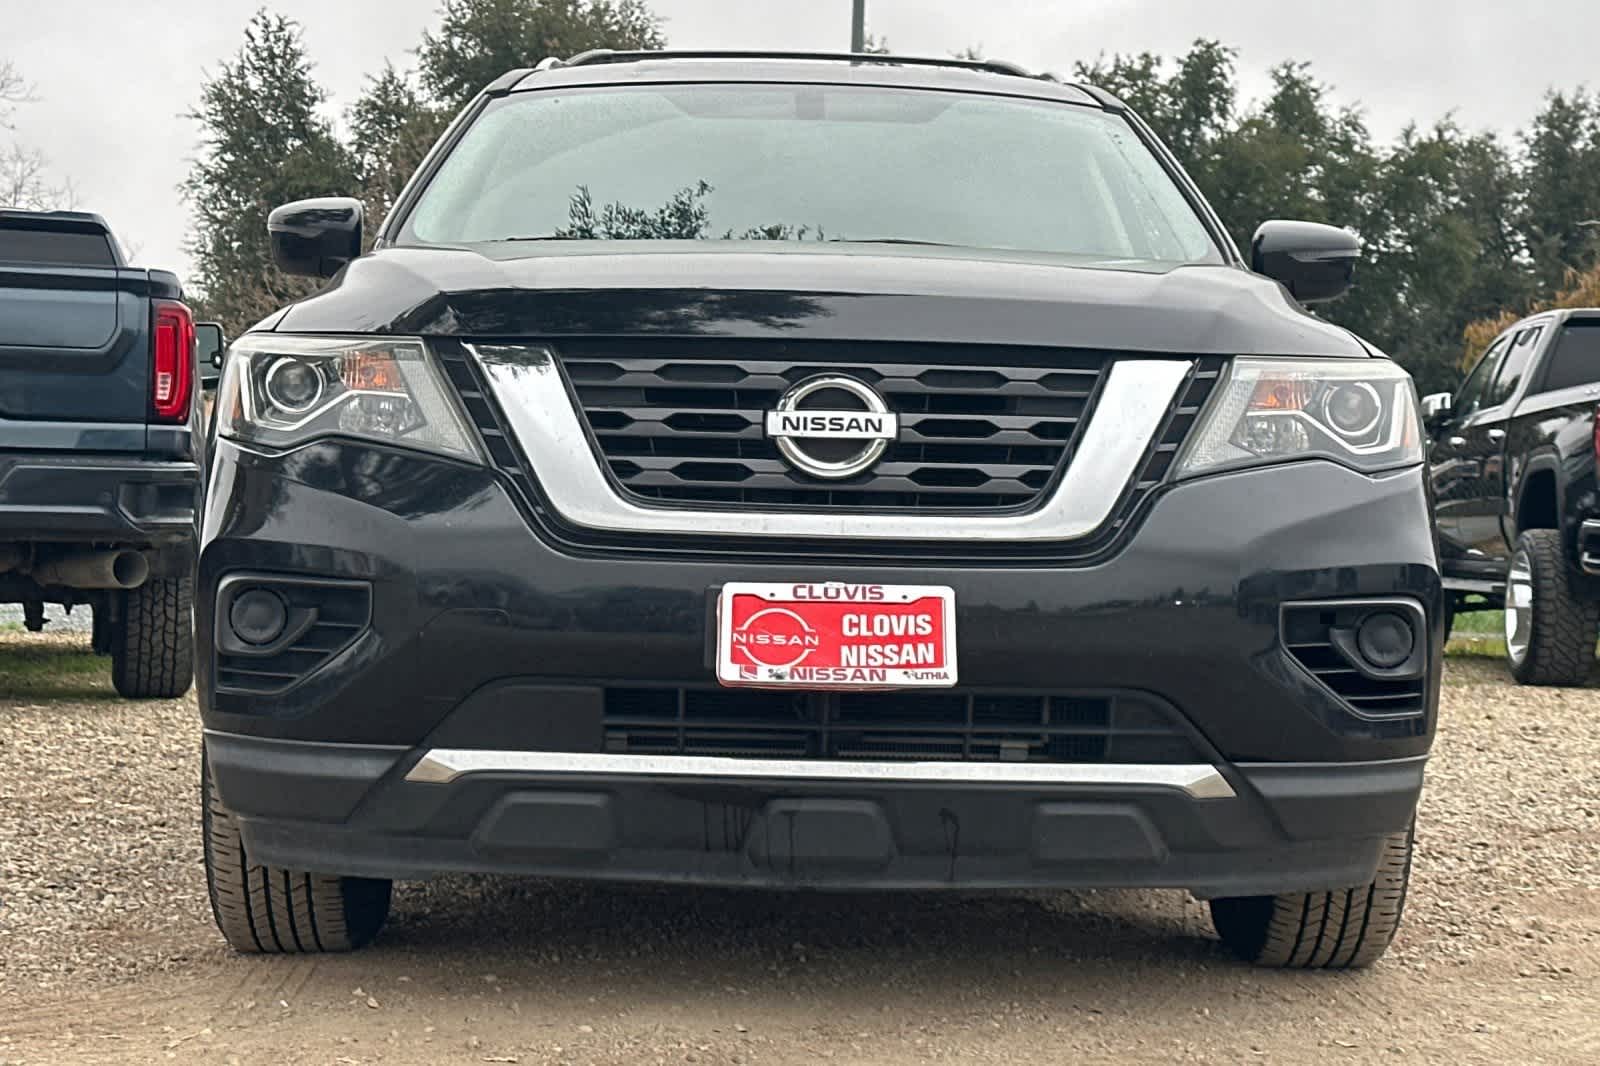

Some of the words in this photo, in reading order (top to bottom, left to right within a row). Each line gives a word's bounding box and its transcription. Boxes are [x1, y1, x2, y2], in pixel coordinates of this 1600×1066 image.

[782, 416, 882, 433] NISSAN
[792, 584, 885, 601] CLOVIS
[842, 613, 932, 637] CLOVIS
[733, 633, 819, 646] NISSAN
[840, 642, 935, 667] NISSAN
[790, 667, 887, 682] NISSAN
[914, 671, 950, 680] LITHIA
